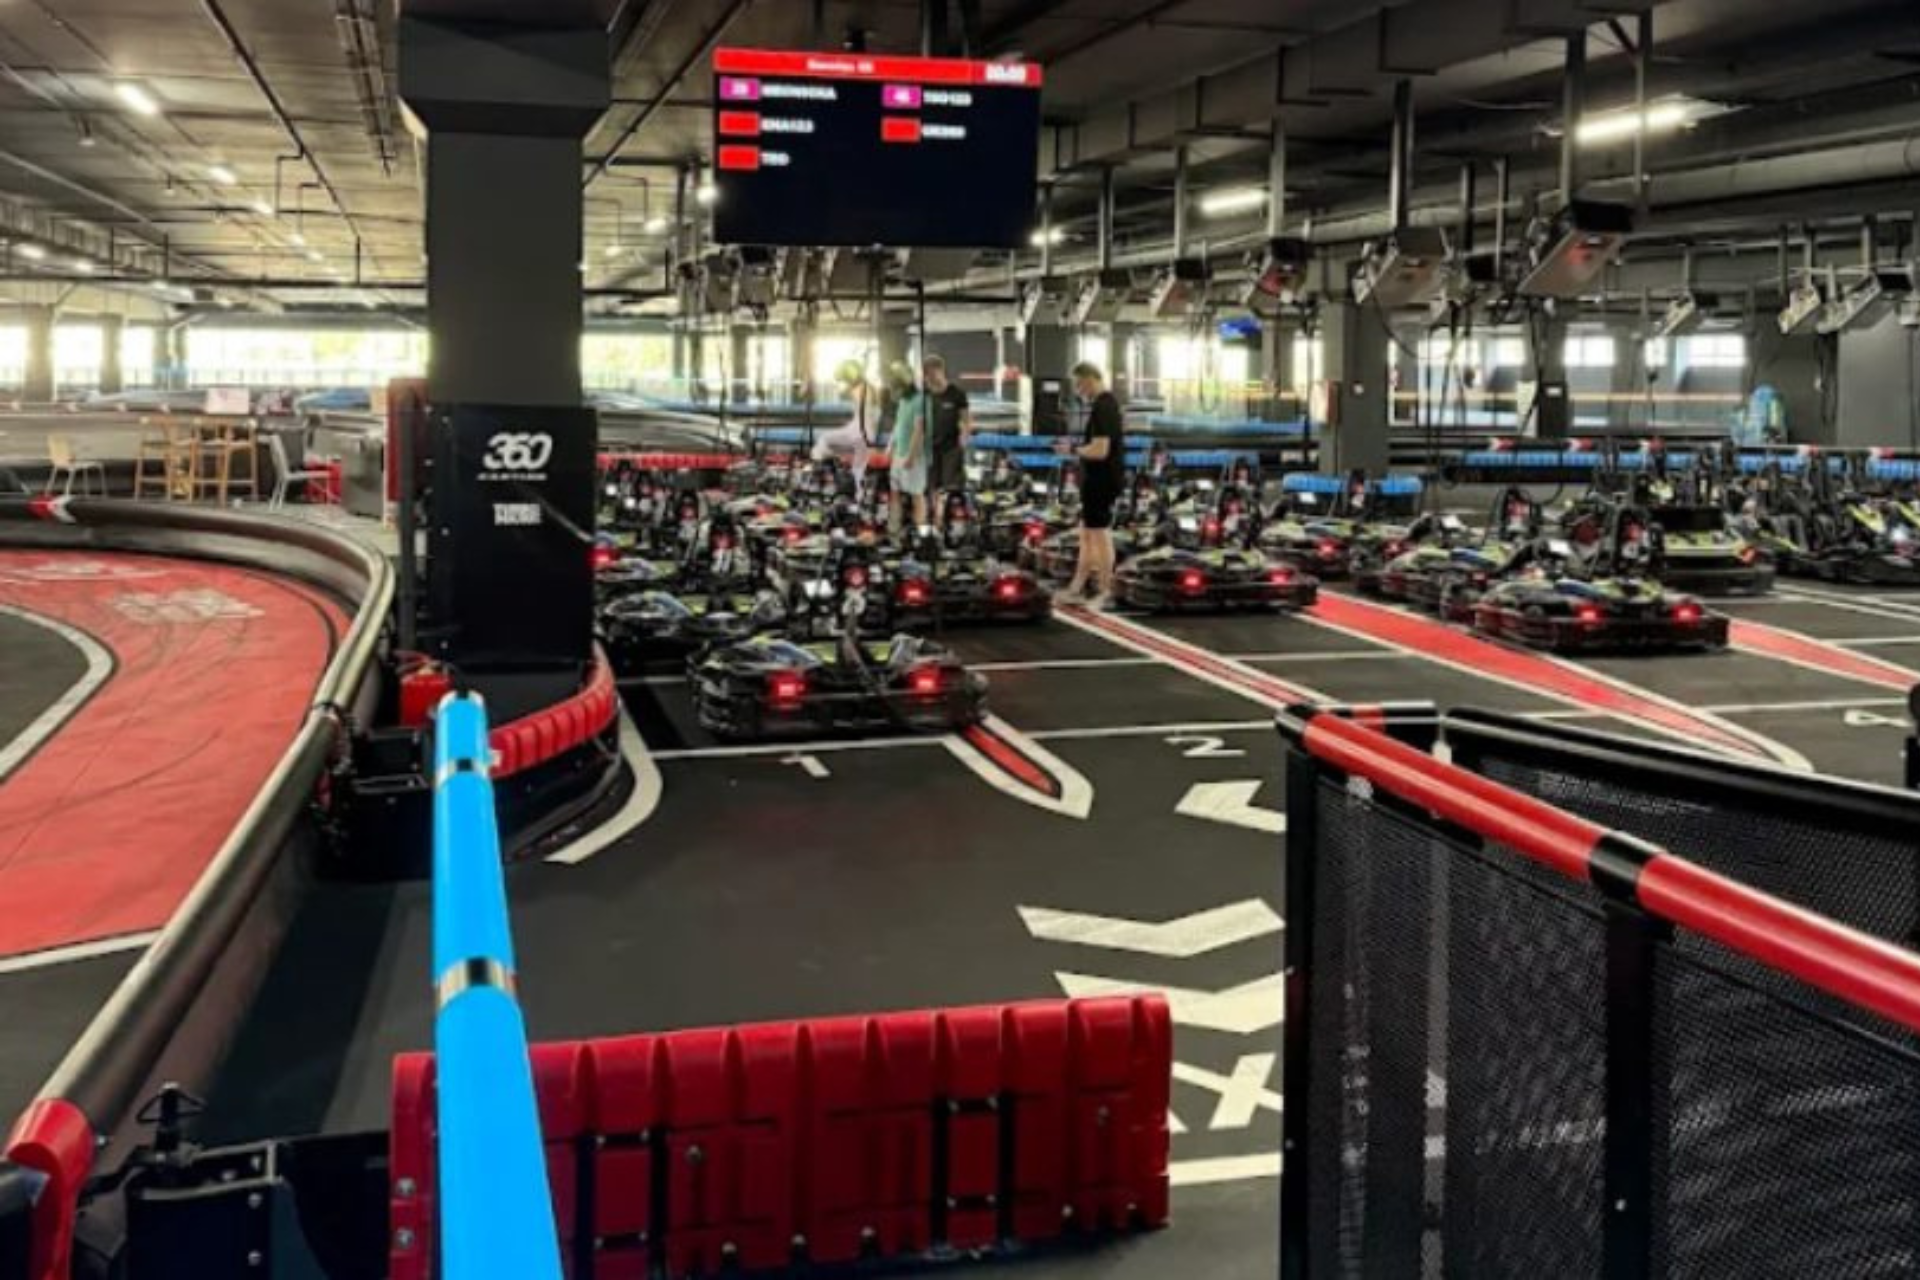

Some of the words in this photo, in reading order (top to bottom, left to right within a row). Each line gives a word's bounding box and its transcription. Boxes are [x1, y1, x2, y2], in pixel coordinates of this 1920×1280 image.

[483, 433, 553, 469] 360
[1165, 736, 1245, 757] 2
[781, 755, 829, 776] 1
